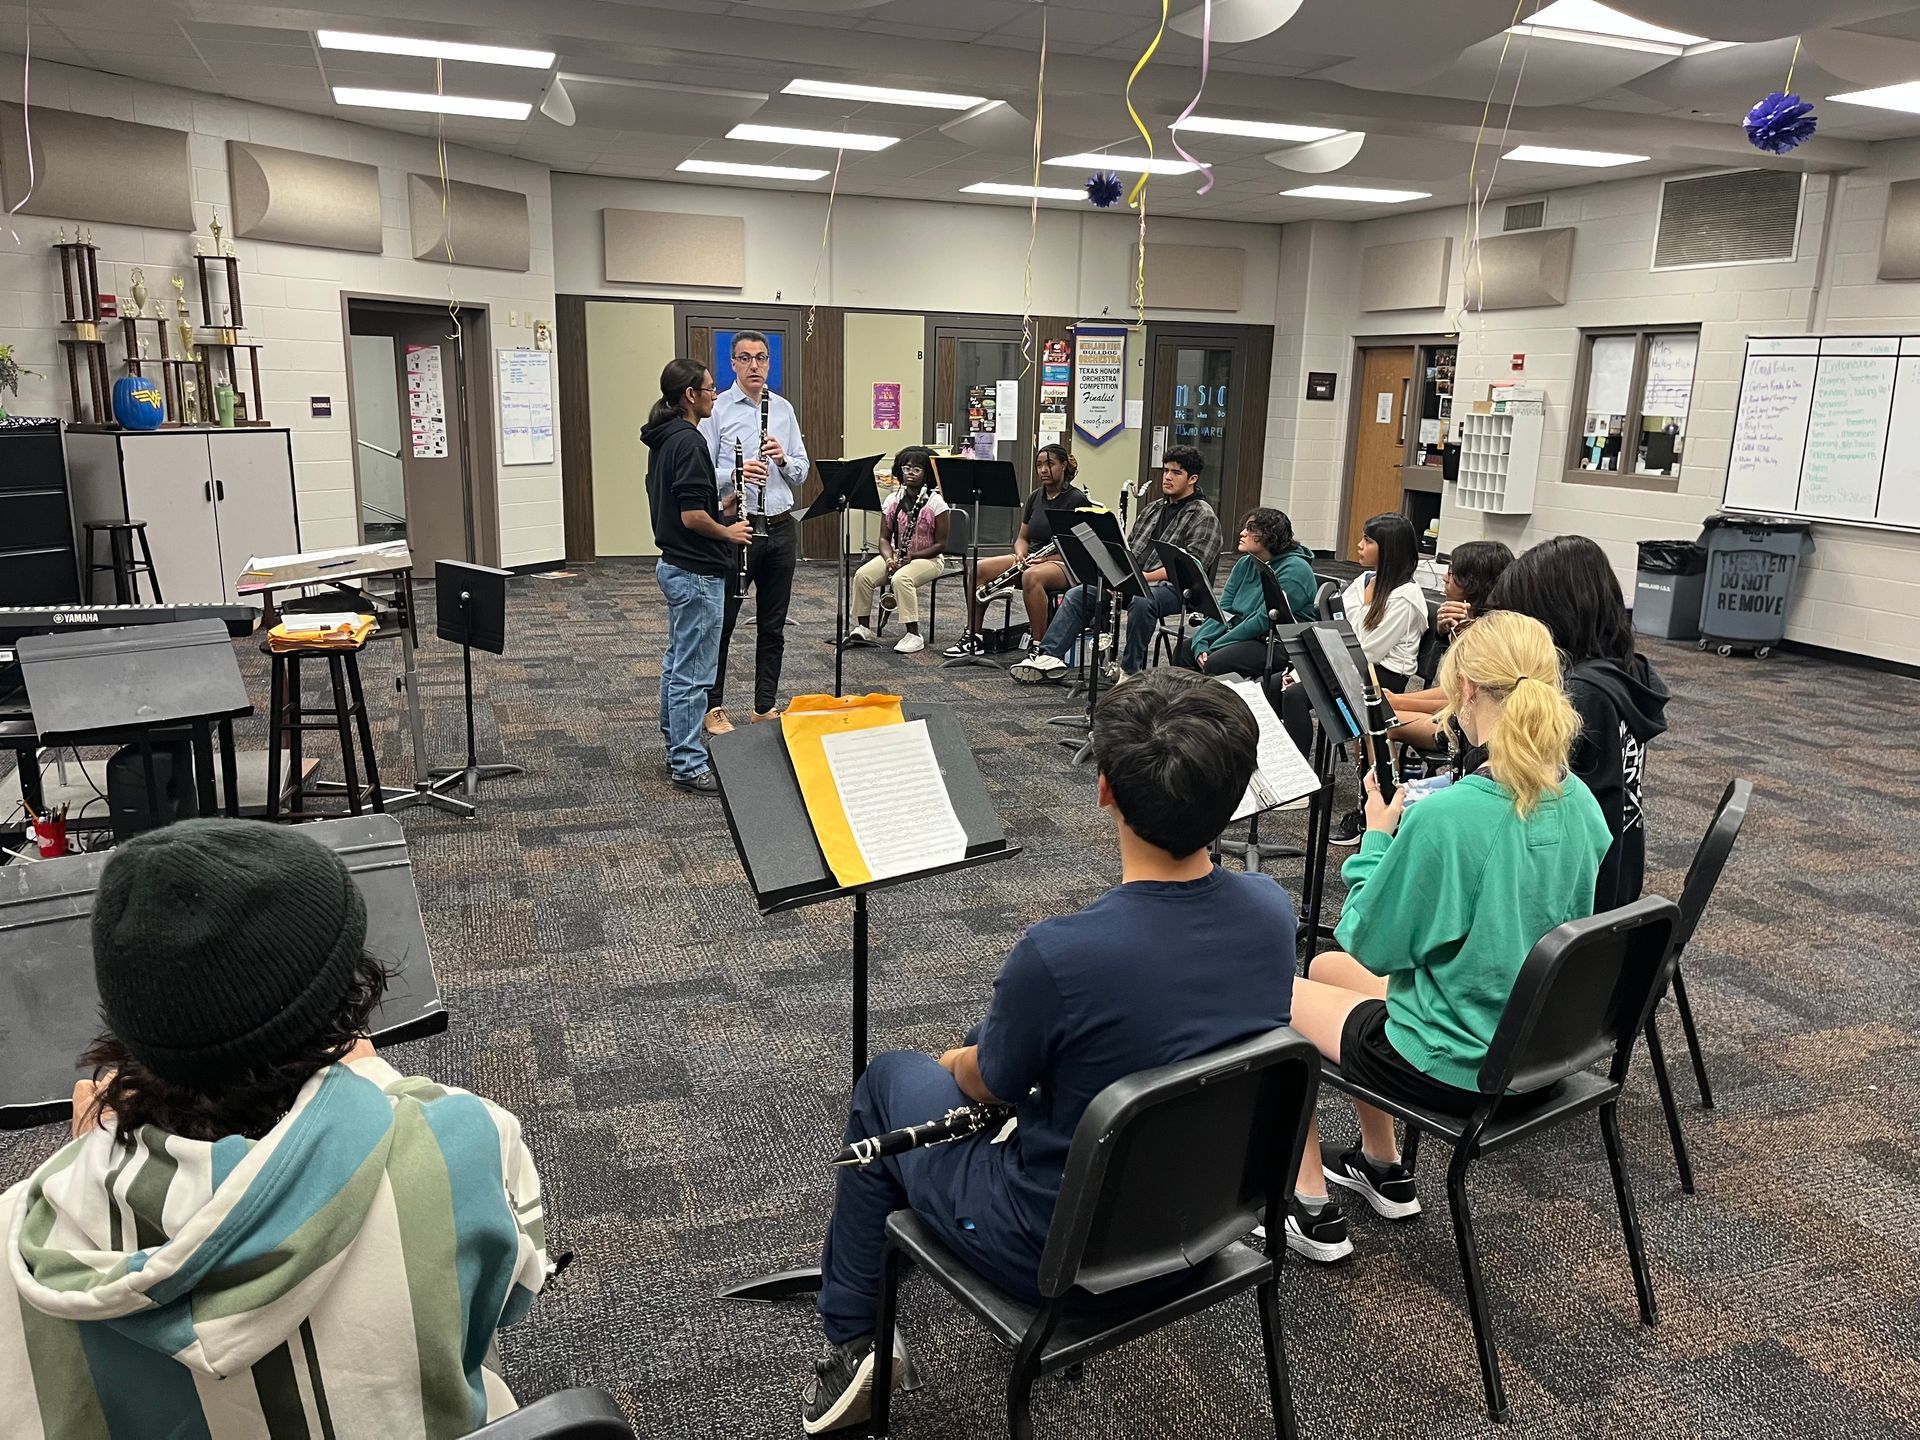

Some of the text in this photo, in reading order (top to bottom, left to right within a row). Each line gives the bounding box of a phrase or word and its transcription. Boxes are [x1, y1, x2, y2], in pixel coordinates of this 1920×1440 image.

[917, 350, 923, 360] B
[1138, 358, 1144, 367] C
[1079, 367, 1121, 375] TEXAS HONOR
[1082, 391, 1115, 404] Finalist
[1720, 573, 1773, 592] DO NOT
[1717, 592, 1784, 615] REMOVE
[64, 613, 99, 623] YAMAHA
